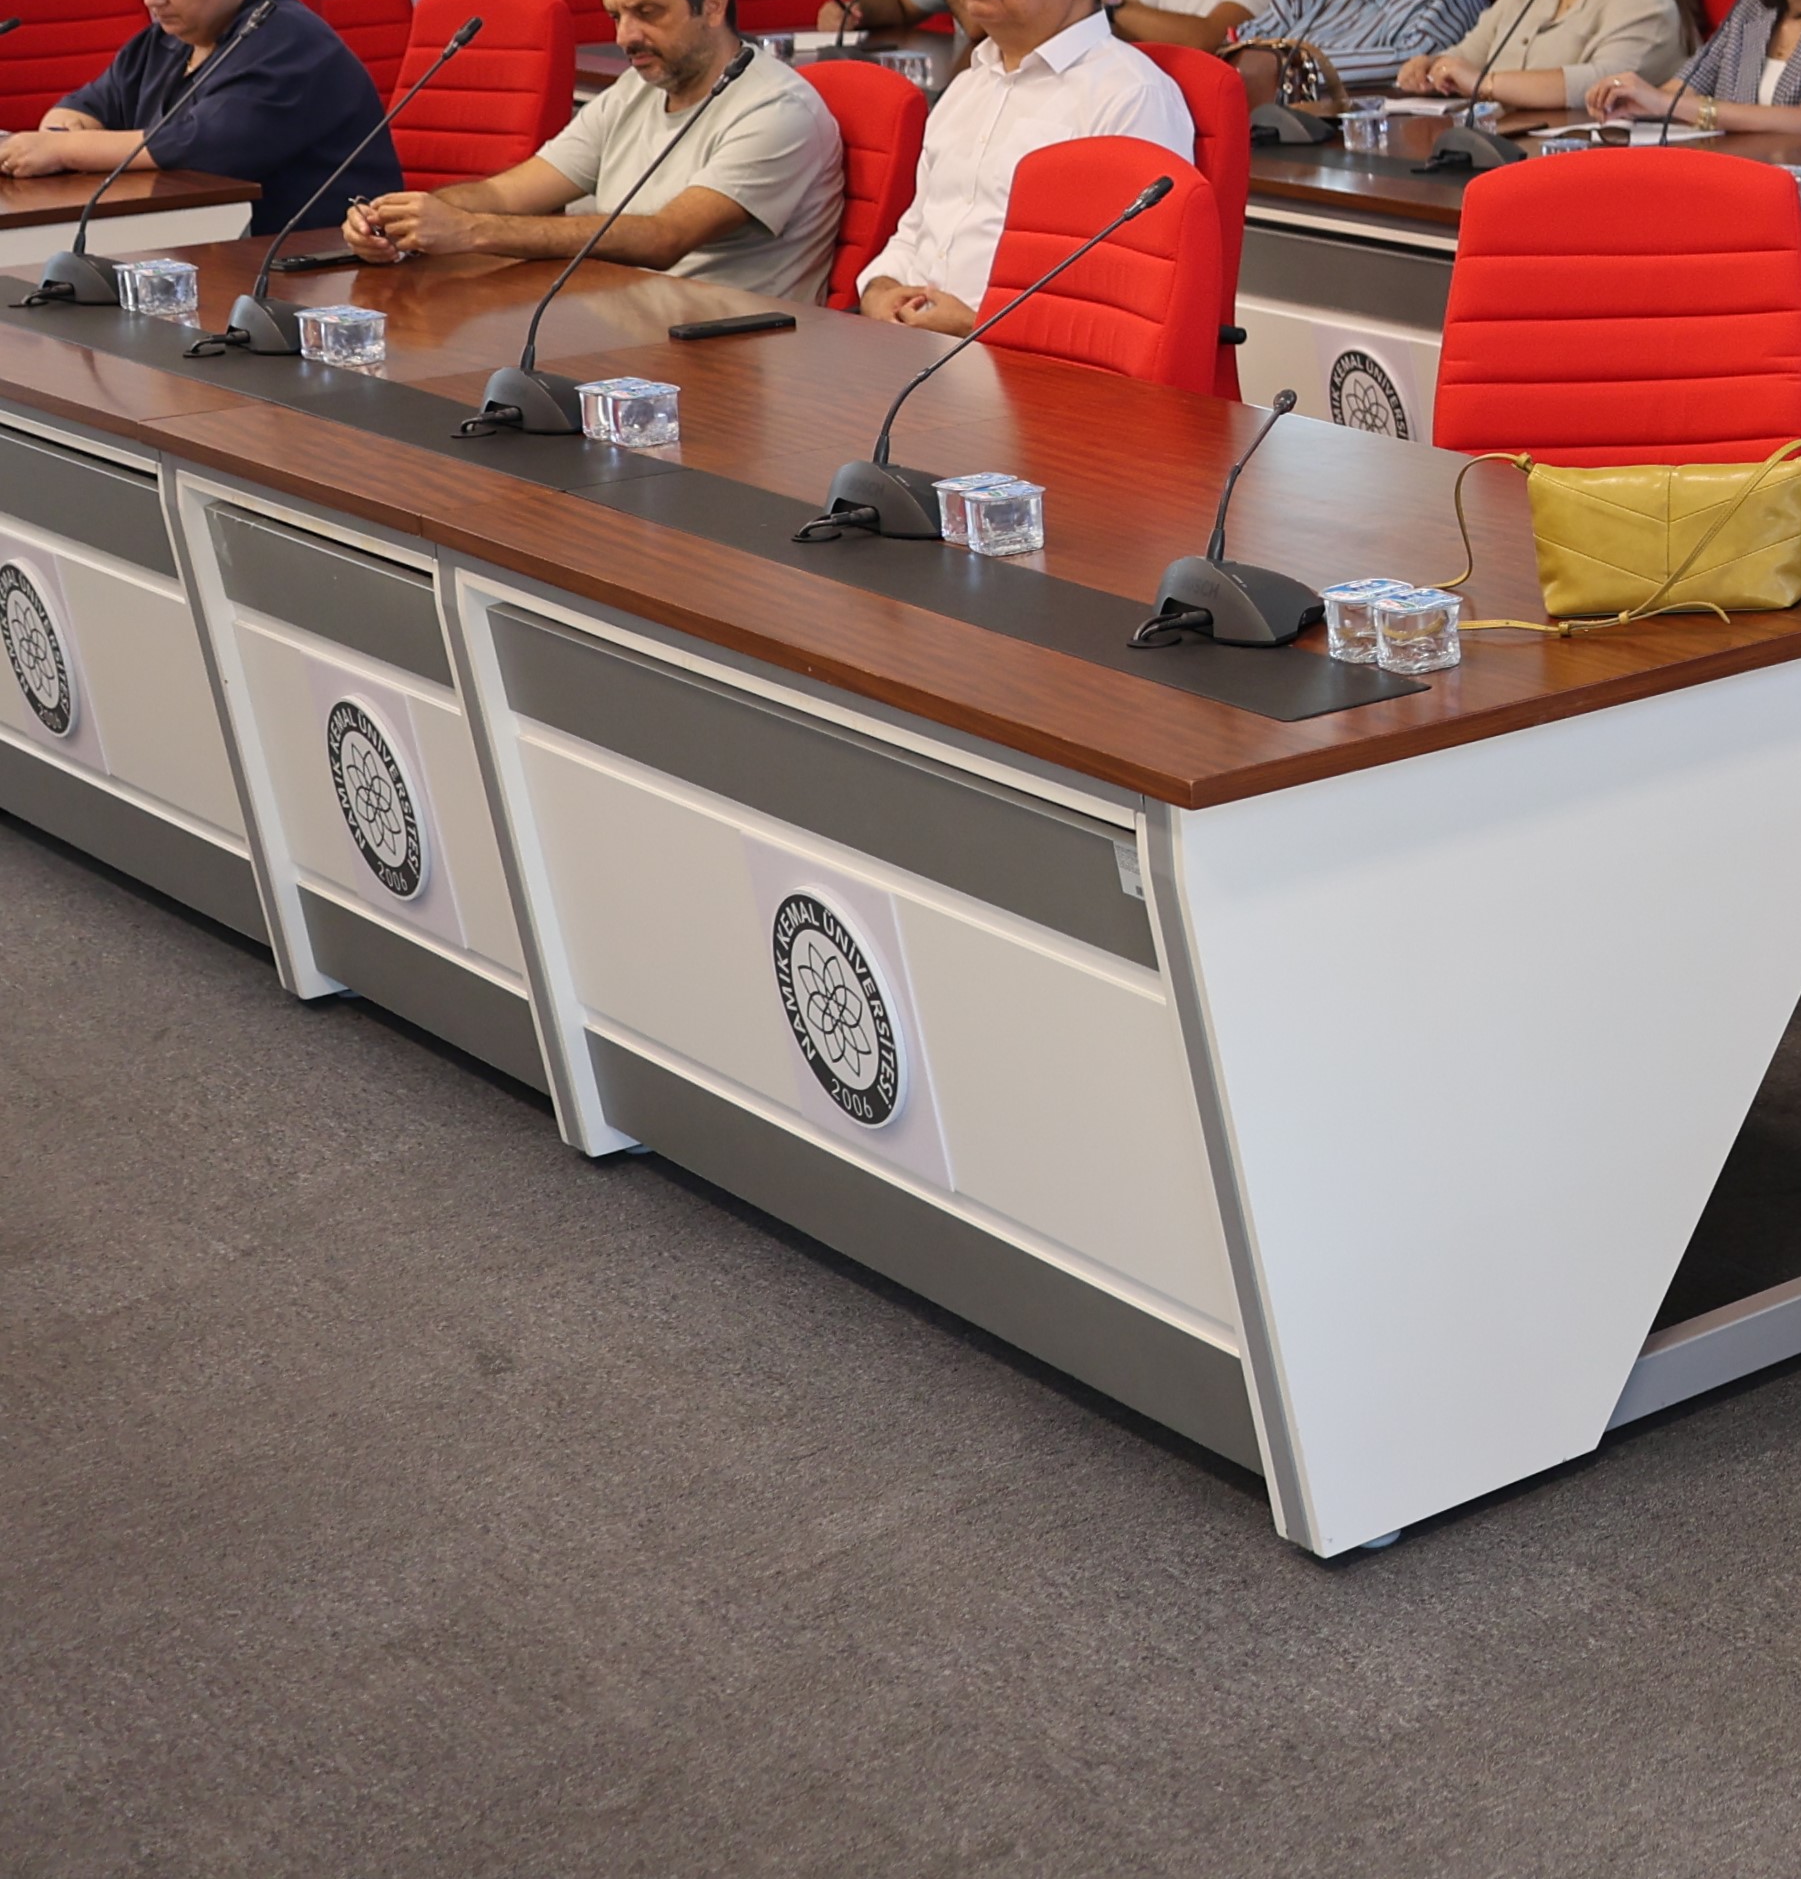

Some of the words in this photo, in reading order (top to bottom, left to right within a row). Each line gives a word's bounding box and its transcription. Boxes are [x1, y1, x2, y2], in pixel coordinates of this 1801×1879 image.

[1333, 354, 1363, 387] KEMAL
[330, 708, 358, 755] KEMAL
[330, 757, 367, 849] NAMIK
[357, 708, 420, 879] ÜNİVERSİTESİ
[377, 860, 408, 891] 2006
[776, 901, 821, 951] KEMAL
[776, 949, 816, 1061] NAMIK
[822, 908, 895, 1110] ÜNİVERSİTESİ
[831, 1078, 874, 1119] 2006
